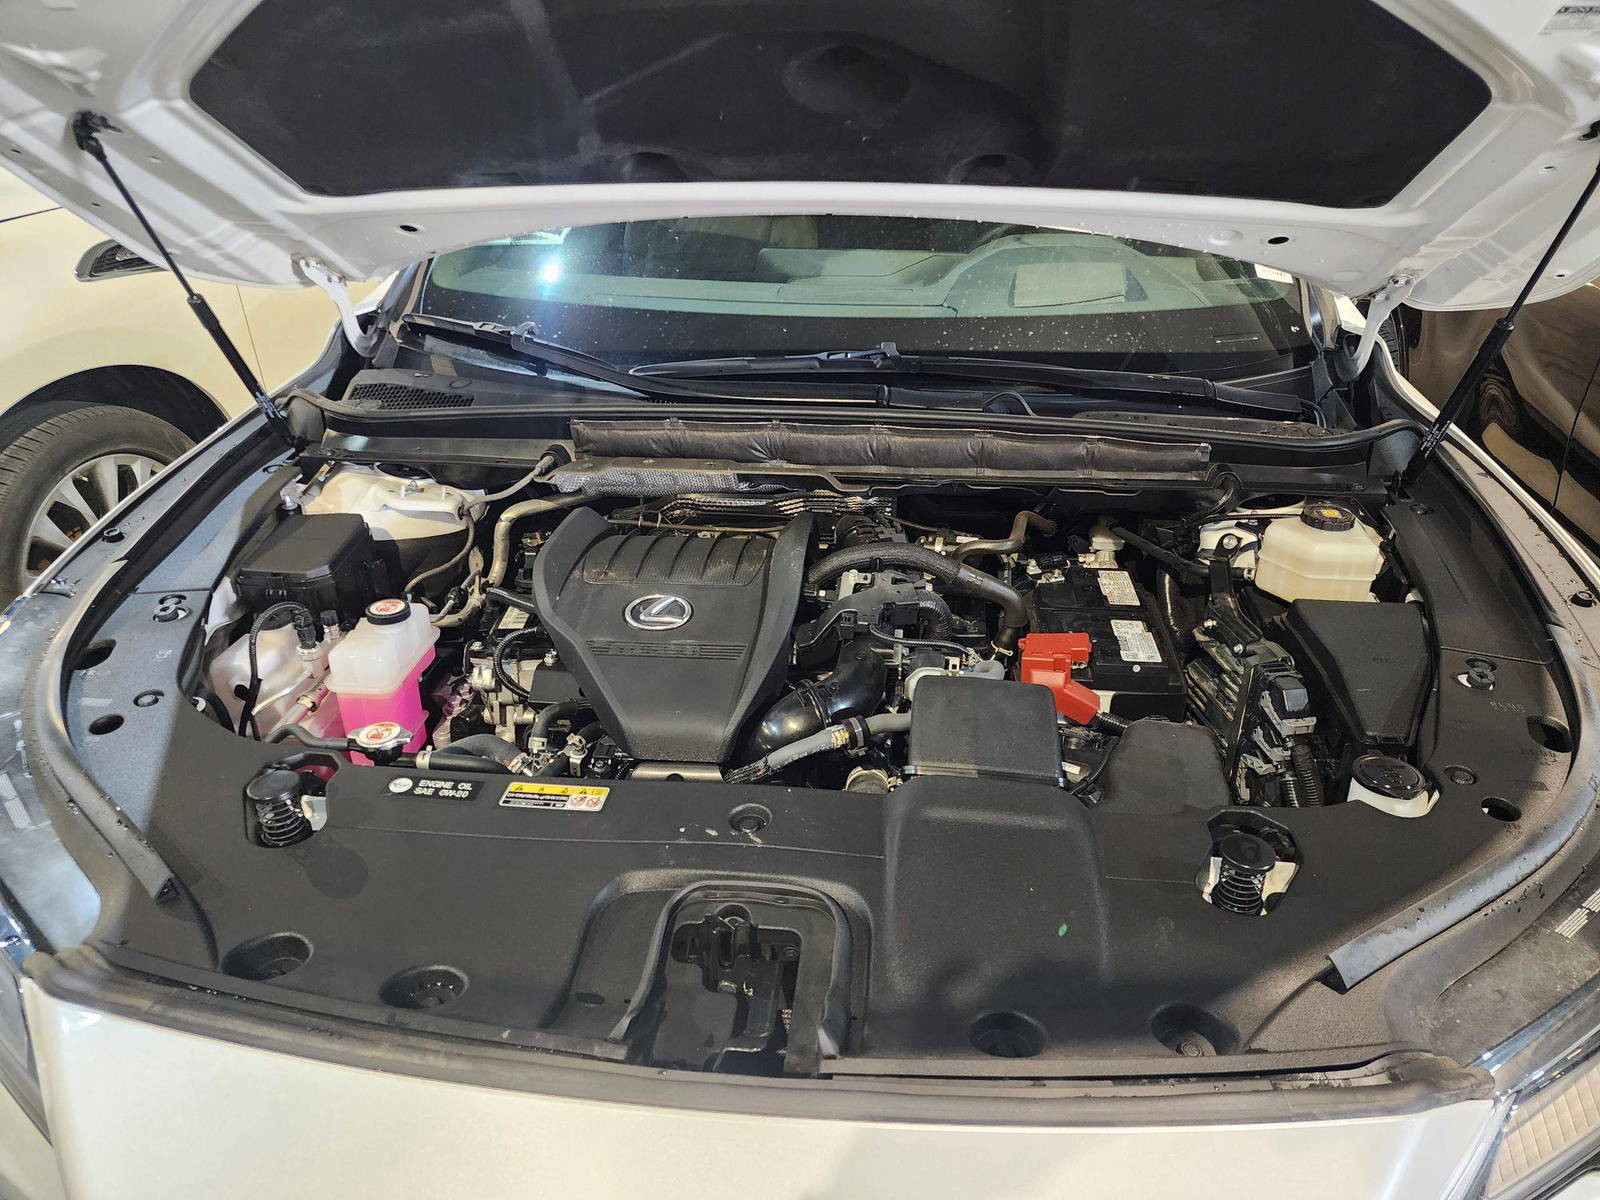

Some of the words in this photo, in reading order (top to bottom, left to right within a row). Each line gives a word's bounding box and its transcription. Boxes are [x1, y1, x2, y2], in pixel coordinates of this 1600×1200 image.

[418, 779, 454, 789] ENGINE
[457, 782, 473, 791] OIL
[413, 787, 435, 796] SAE
[438, 788, 469, 798] 0W-20
